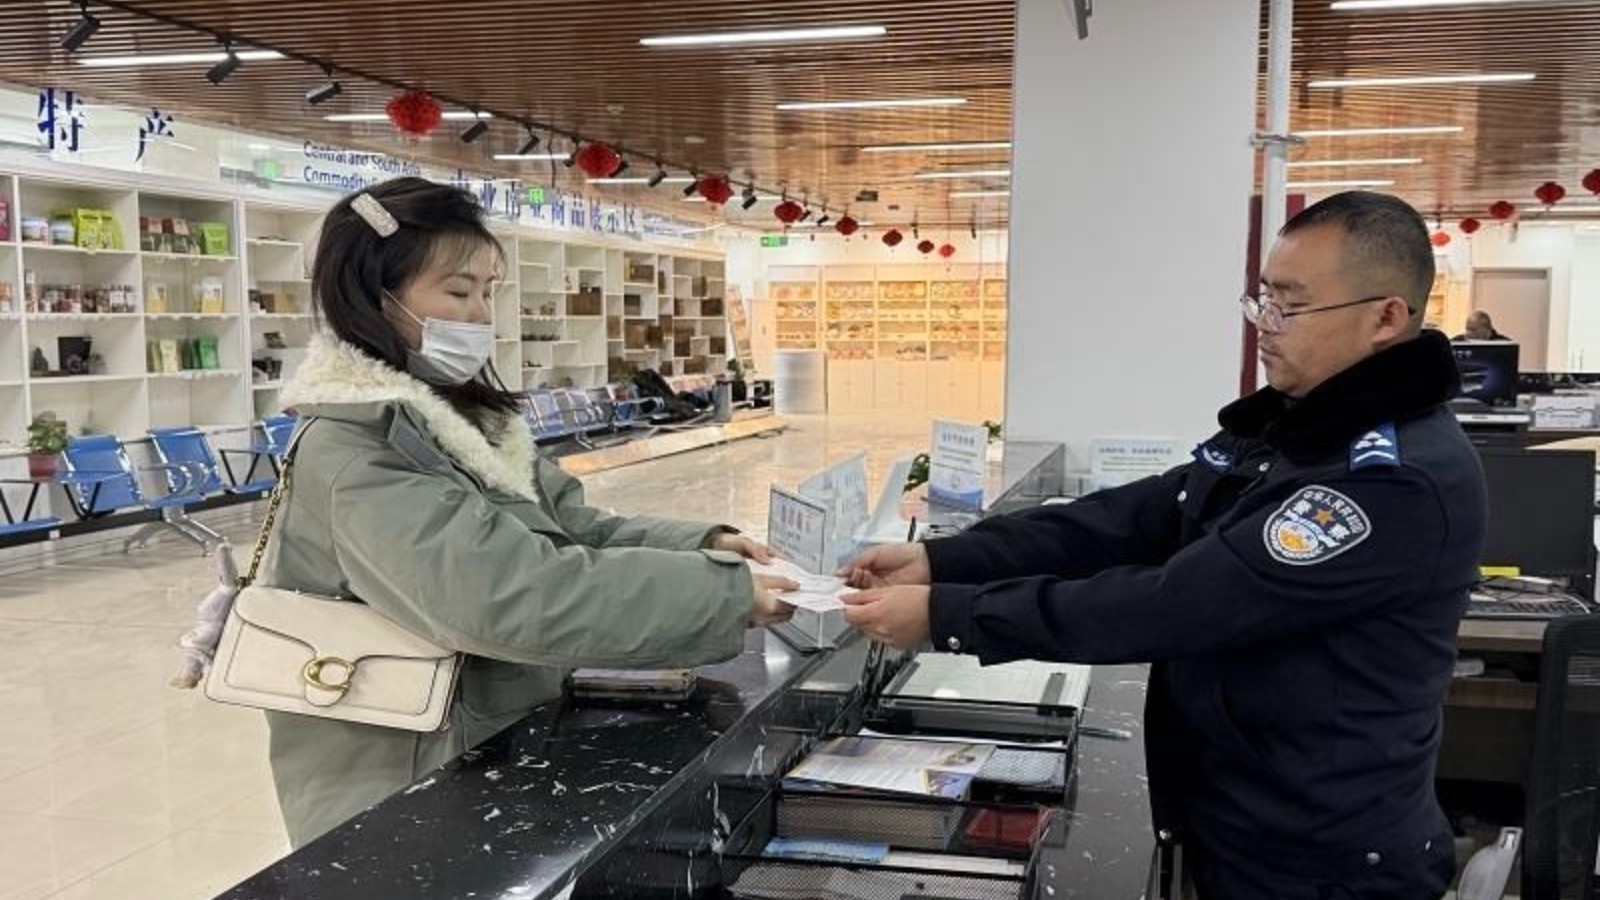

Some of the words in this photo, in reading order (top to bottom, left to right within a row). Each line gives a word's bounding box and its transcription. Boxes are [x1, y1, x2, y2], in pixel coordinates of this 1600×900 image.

[303, 140, 347, 164] Central
[348, 150, 369, 167] and
[371, 154, 400, 175] South
